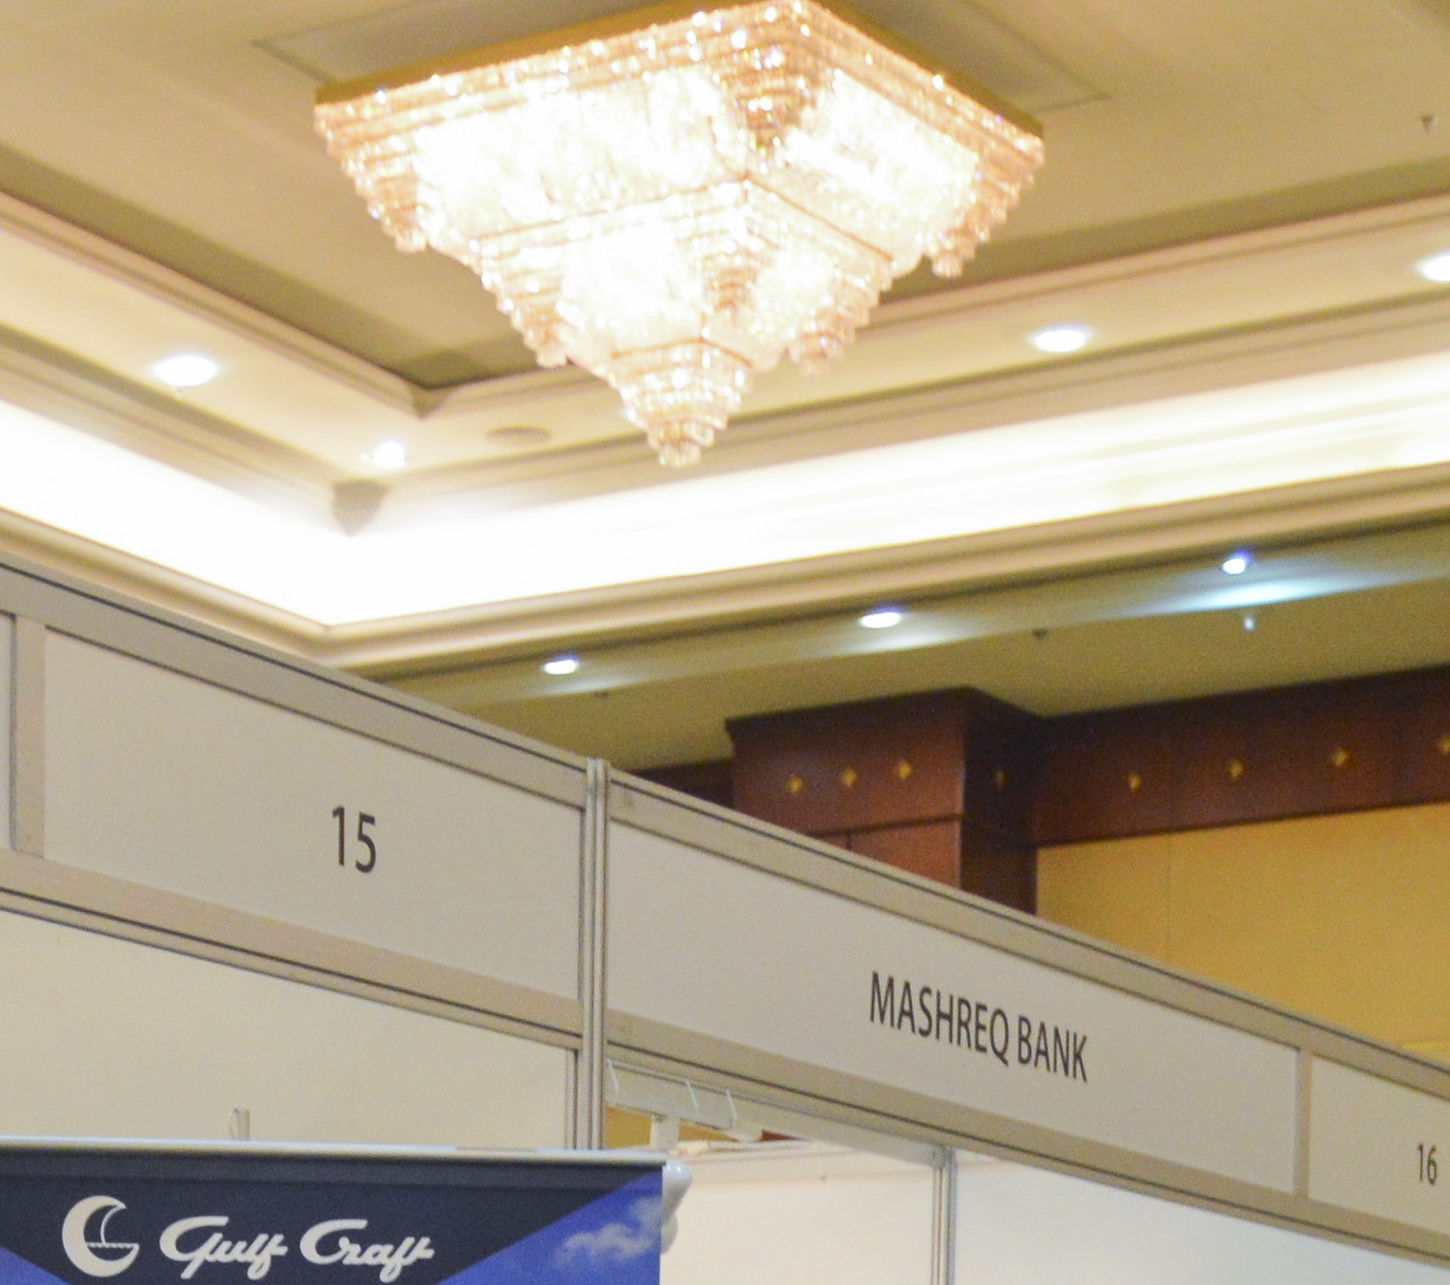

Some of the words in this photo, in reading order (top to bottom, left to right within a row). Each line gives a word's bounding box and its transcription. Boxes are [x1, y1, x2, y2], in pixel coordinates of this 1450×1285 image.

[330, 805, 378, 874] 15
[868, 971, 1011, 1065] MASHREQ
[1016, 1015, 1089, 1083] BANK
[1416, 1143, 1438, 1186] 16
[158, 1213, 290, 1281] Gulf
[299, 1217, 436, 1284] Craft
